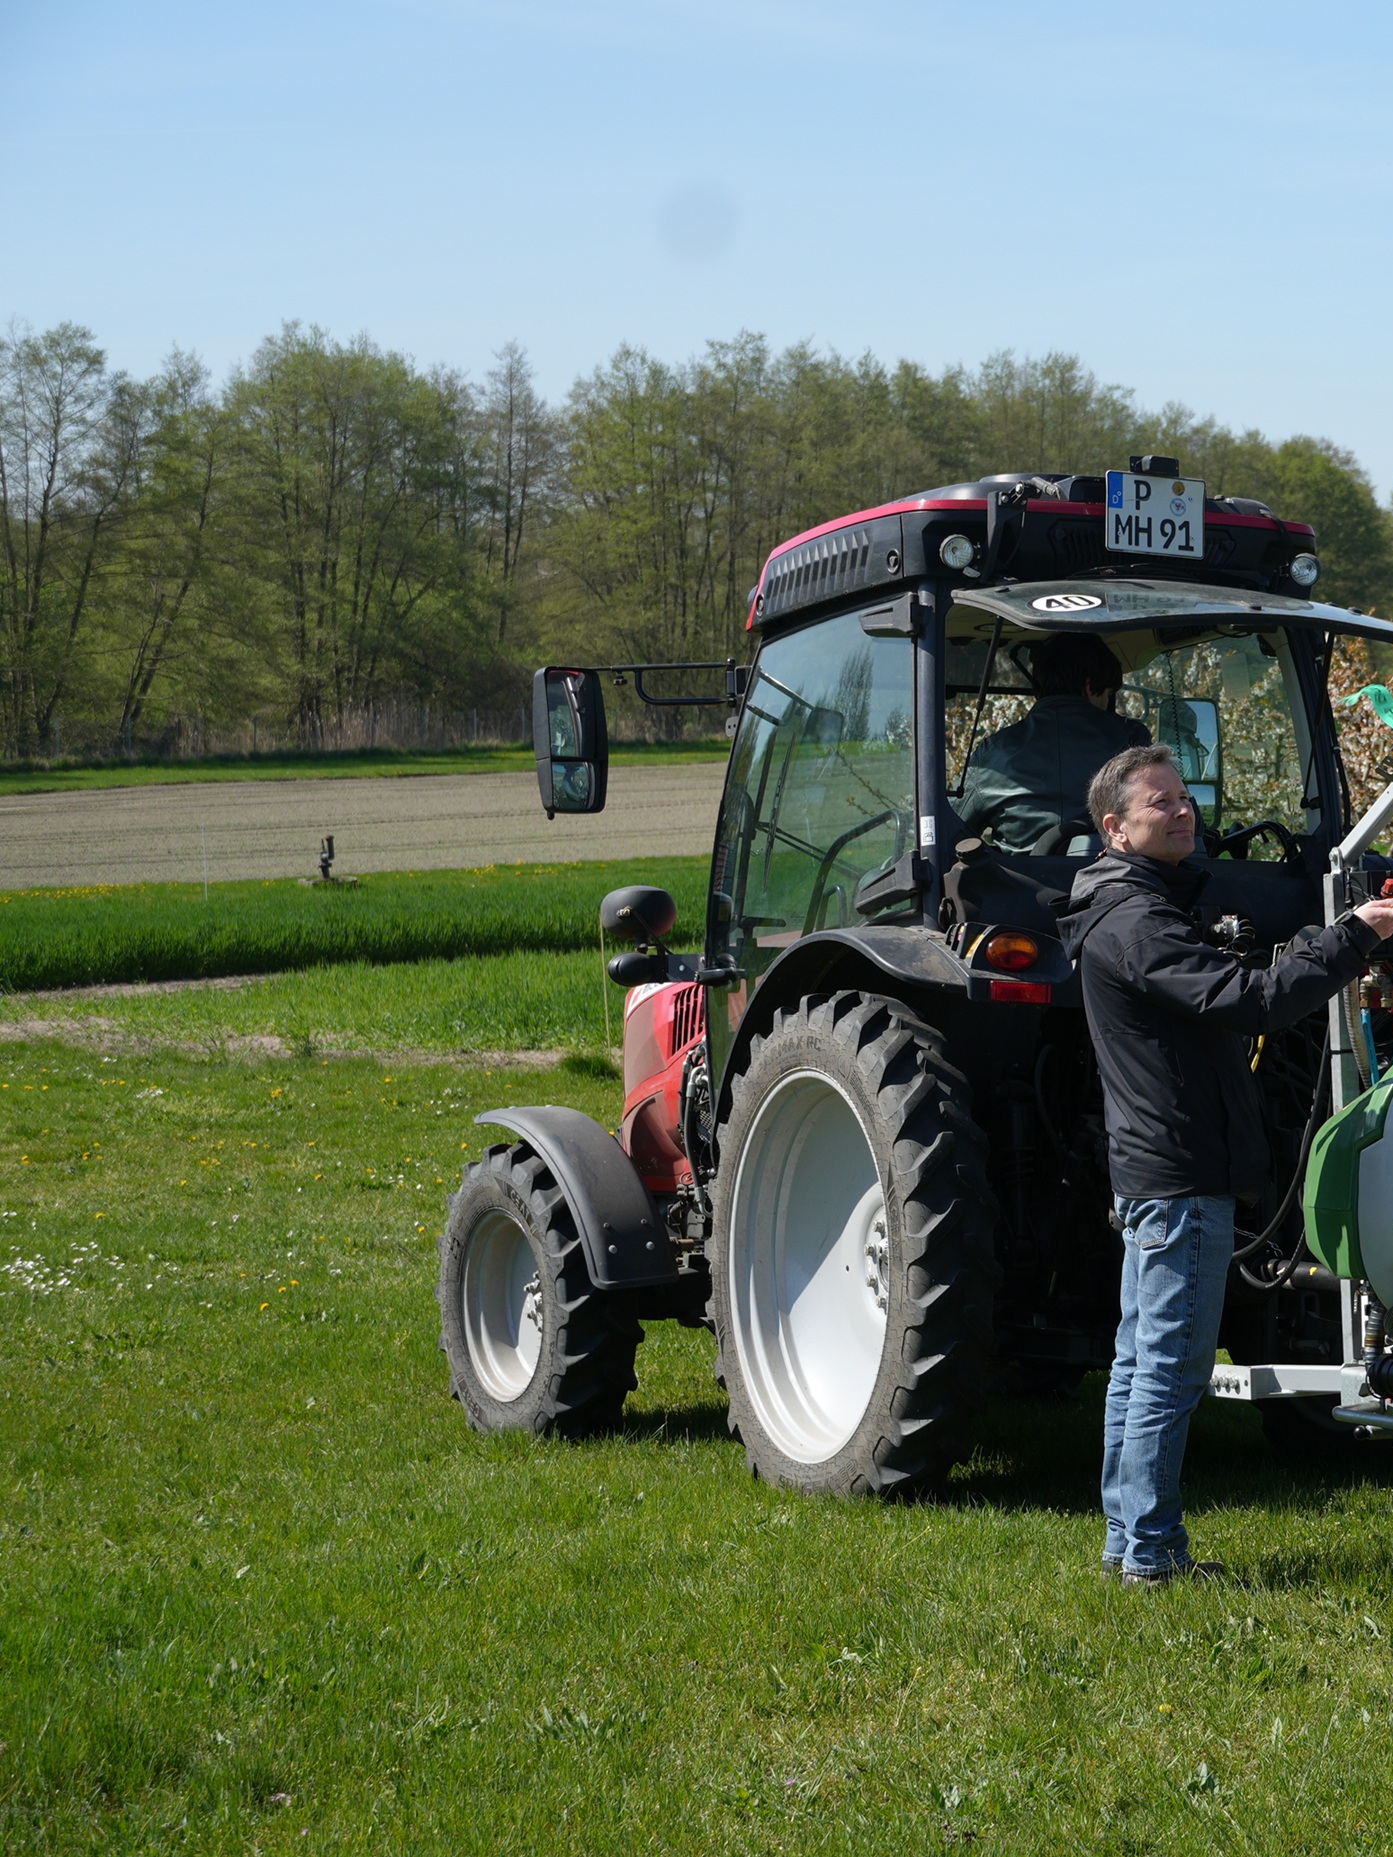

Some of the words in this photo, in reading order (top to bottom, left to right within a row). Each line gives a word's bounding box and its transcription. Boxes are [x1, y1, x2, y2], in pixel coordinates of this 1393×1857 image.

[1112, 494, 1119, 504] D
[1134, 480, 1152, 510] P
[1115, 513, 1152, 548] MH
[1160, 518, 1194, 552] 91
[1046, 595, 1096, 610] 40
